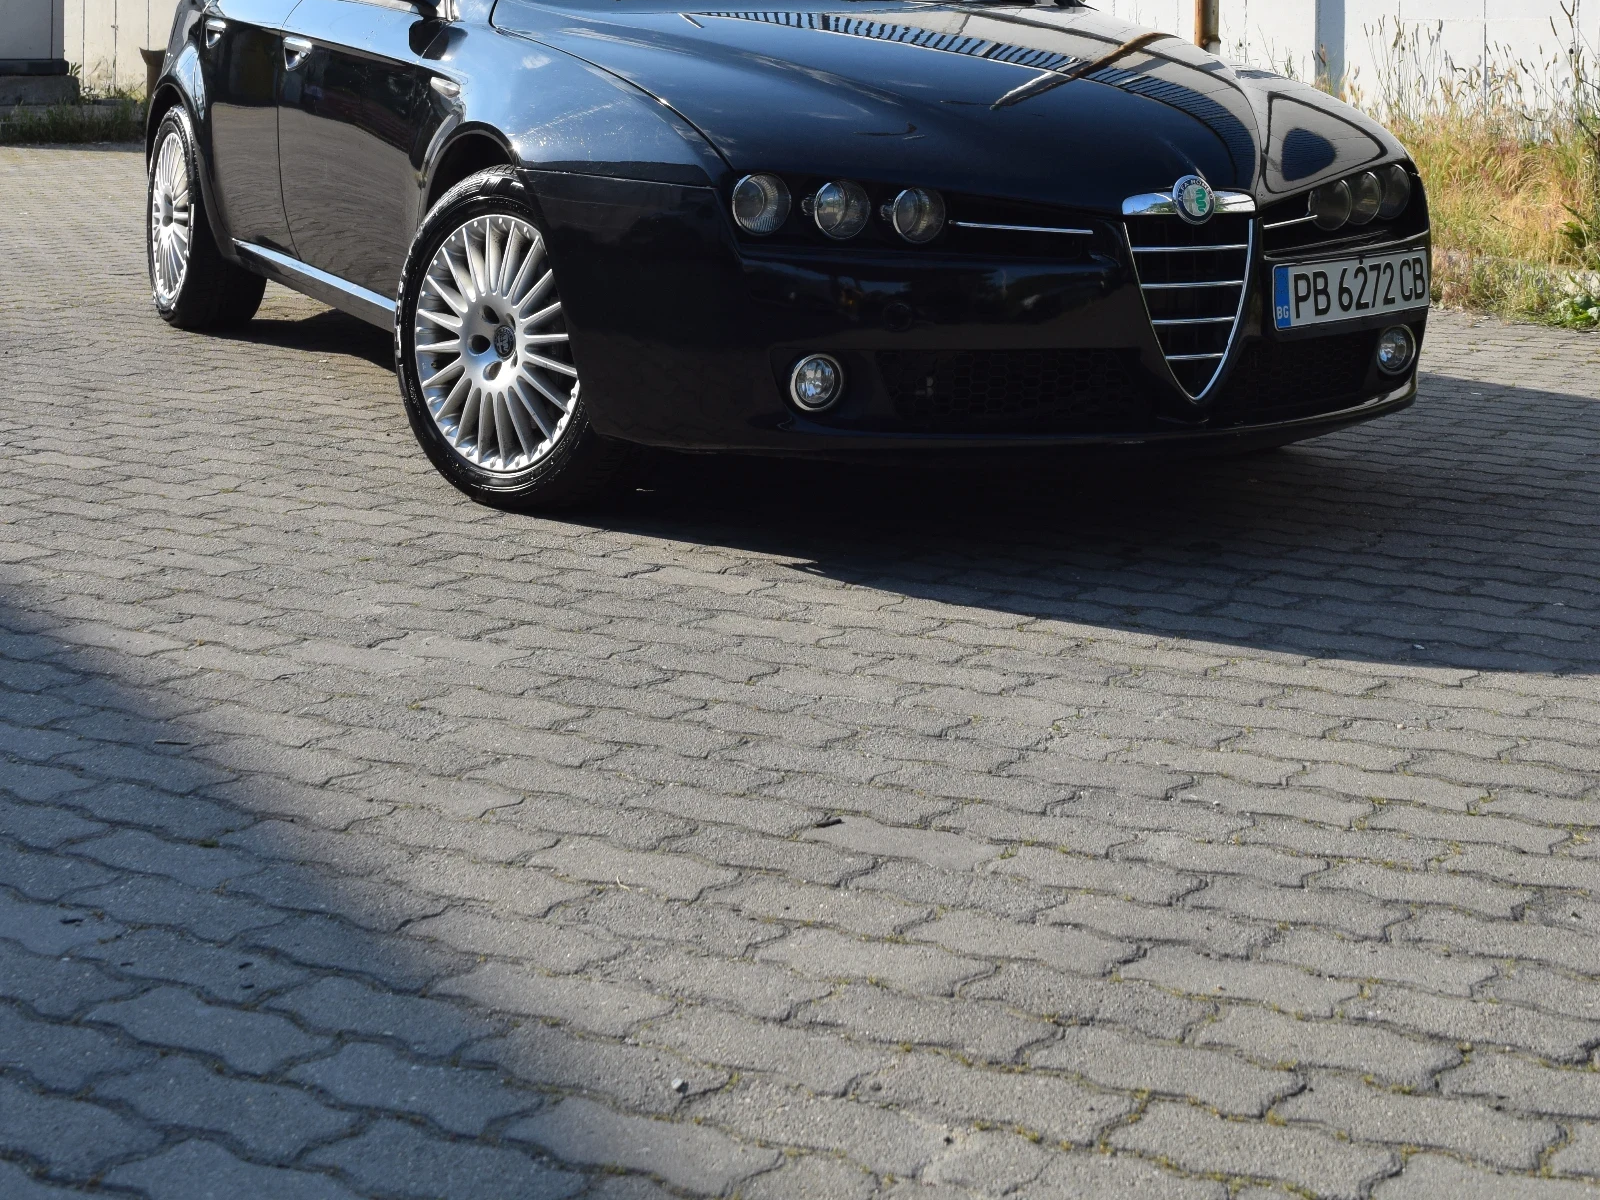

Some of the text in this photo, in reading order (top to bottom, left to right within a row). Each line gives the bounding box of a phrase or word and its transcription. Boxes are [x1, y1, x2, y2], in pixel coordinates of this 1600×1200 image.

[1293, 256, 1426, 319] PB 6272 CB
[1276, 305, 1289, 320] BG
